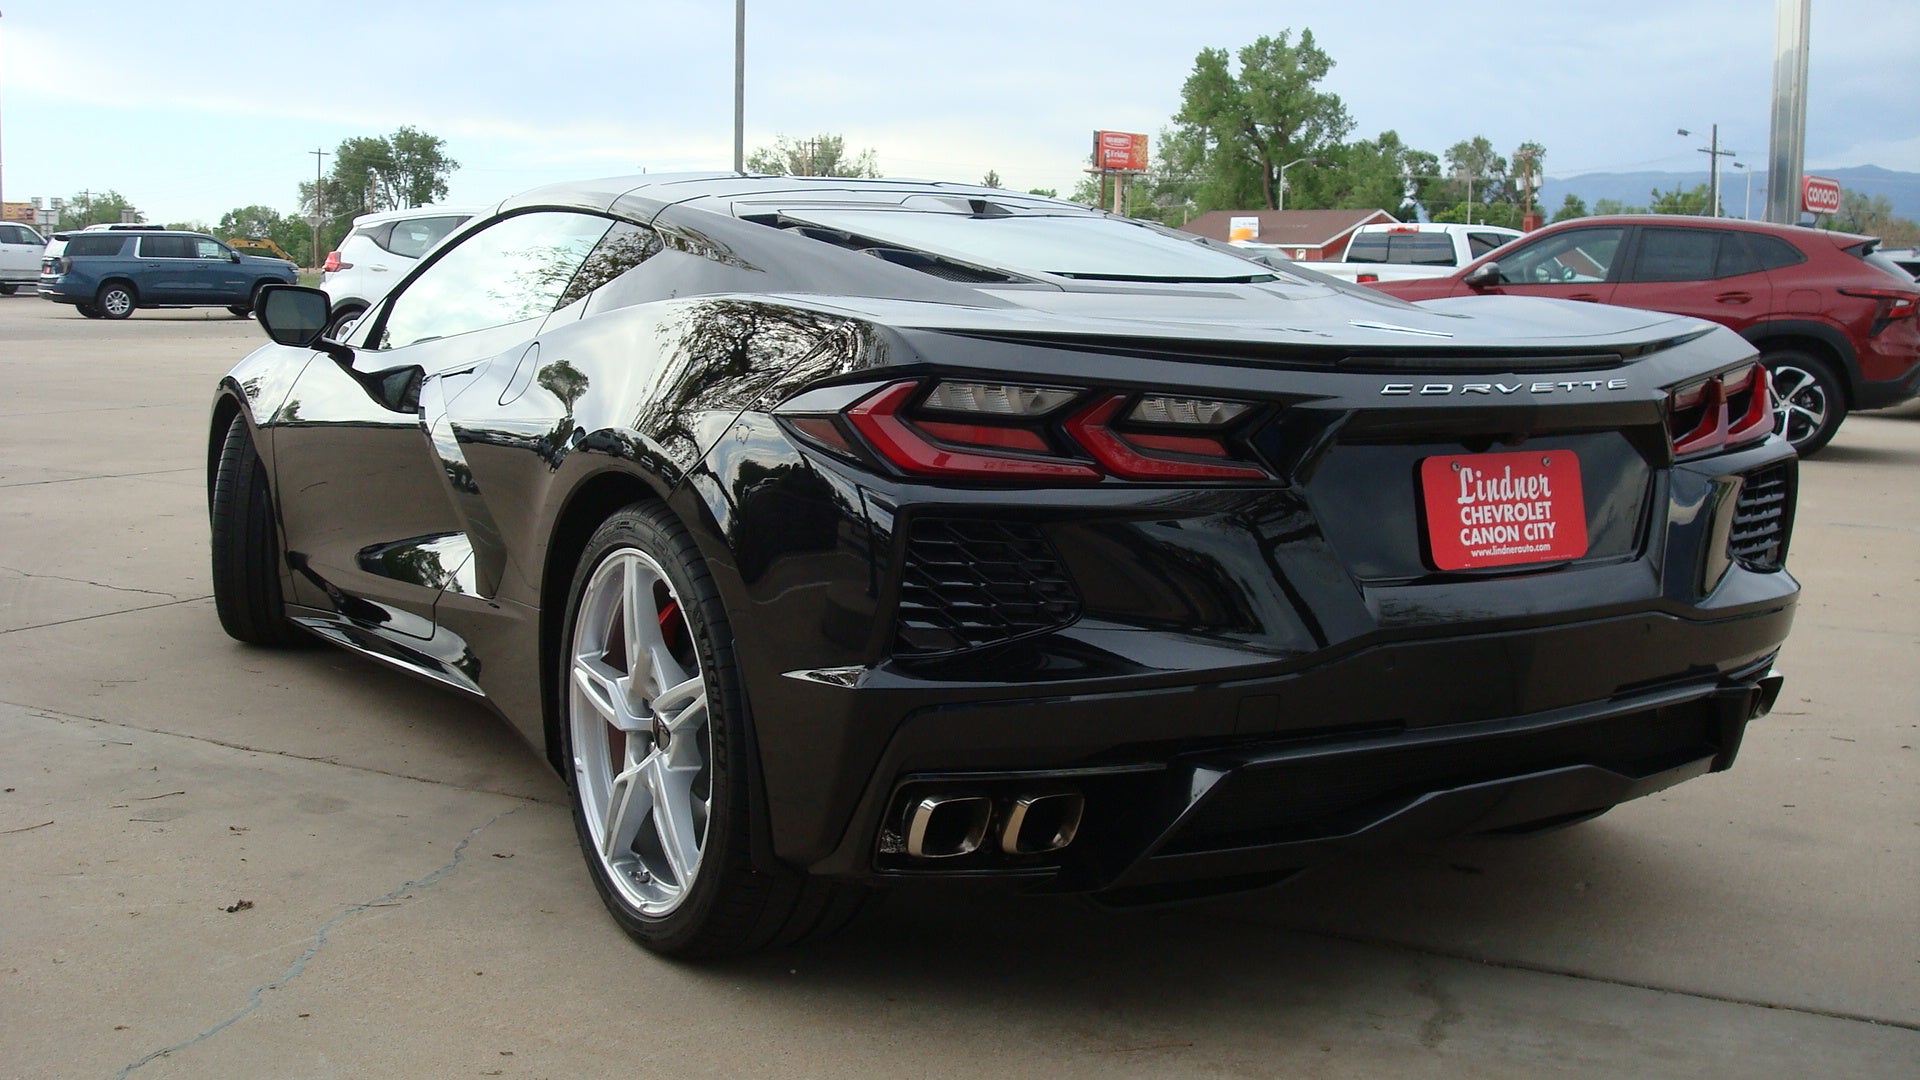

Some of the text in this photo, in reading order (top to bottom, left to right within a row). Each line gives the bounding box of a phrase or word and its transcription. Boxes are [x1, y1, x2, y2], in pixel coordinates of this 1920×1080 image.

[1380, 378, 1628, 395] CORVETTE
[1457, 466, 1551, 504] Lindner
[1460, 501, 1552, 526] CHEVROLET
[1460, 521, 1556, 546] CANON CITY
[1471, 544, 1551, 557] www.lindnerauto.com
